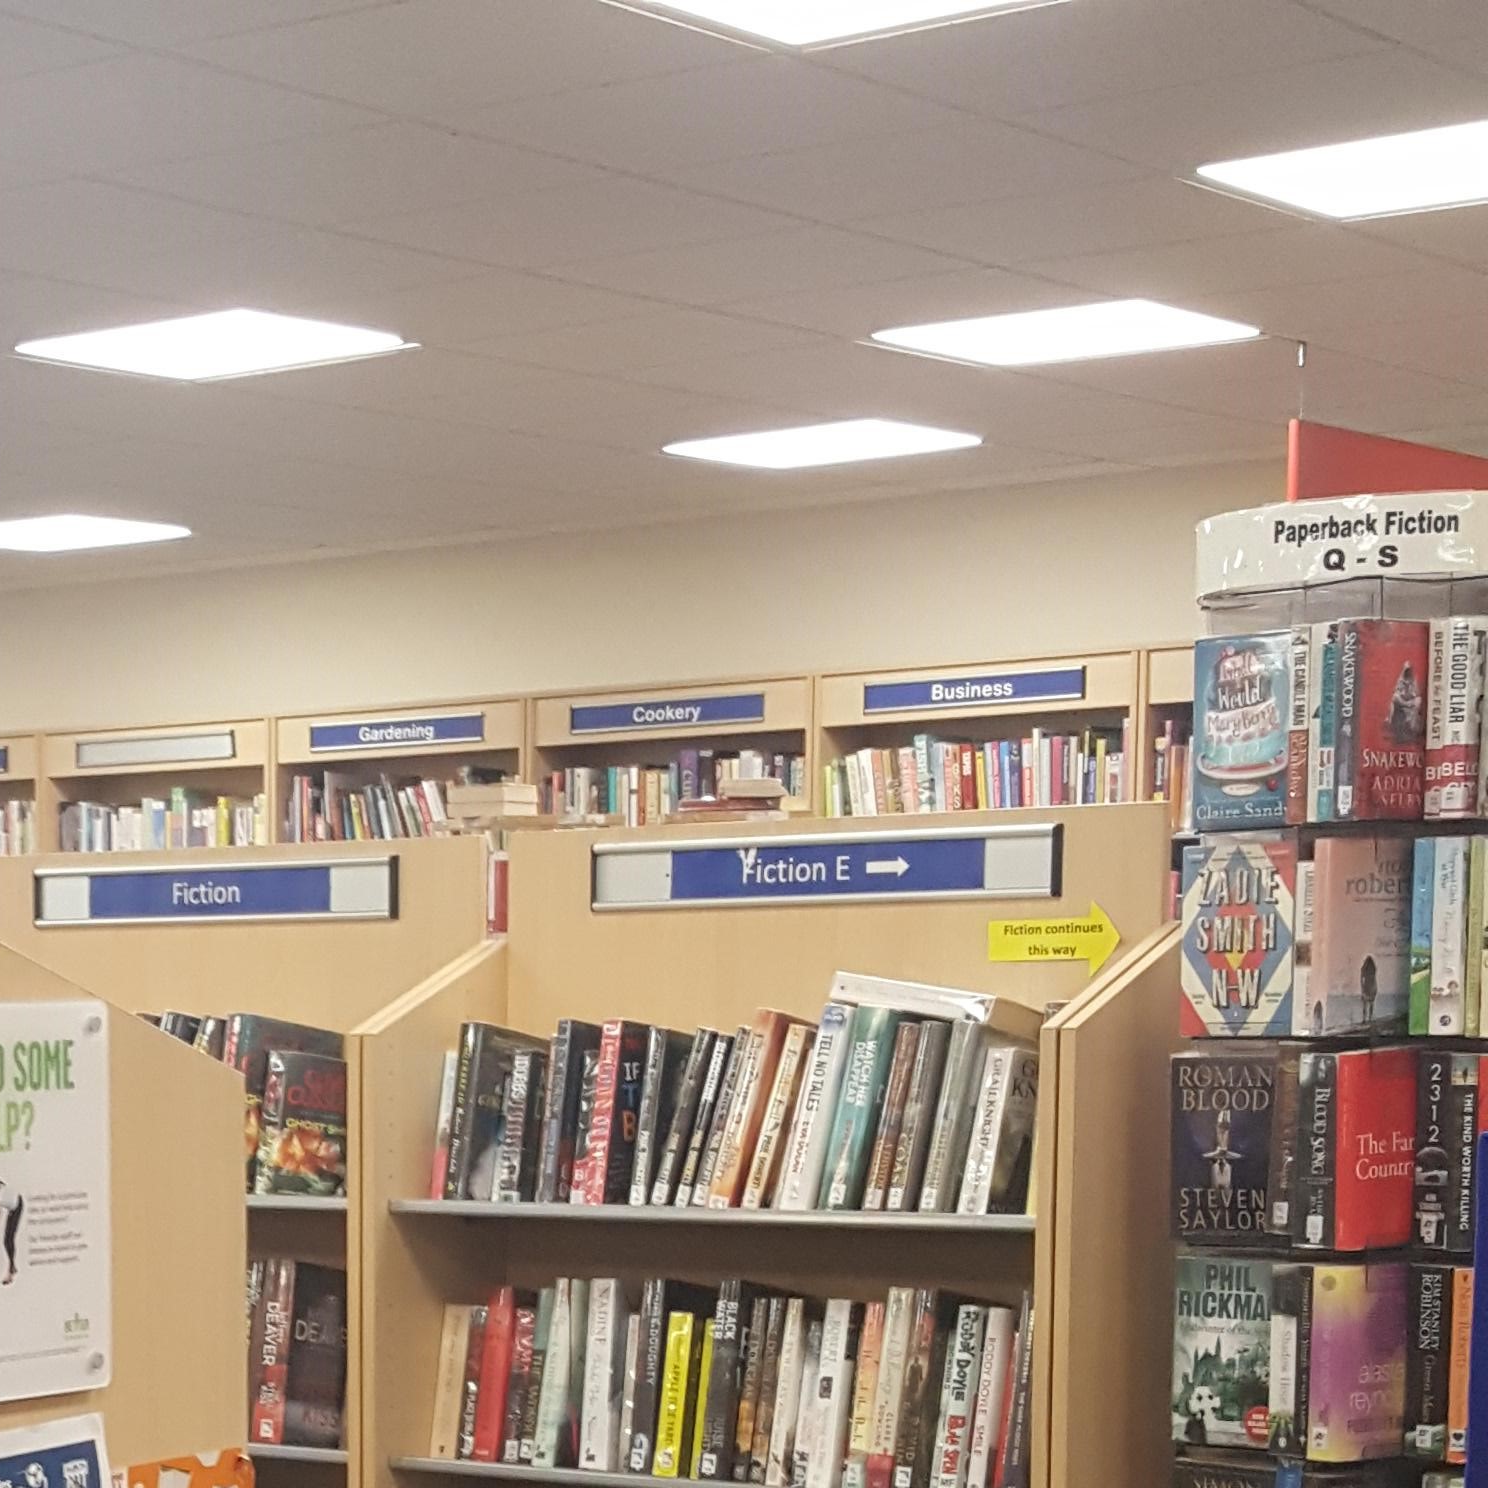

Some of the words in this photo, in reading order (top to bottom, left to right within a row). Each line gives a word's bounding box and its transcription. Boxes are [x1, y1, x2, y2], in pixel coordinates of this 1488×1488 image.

[1274, 514, 1378, 545] Paperback
[1385, 510, 1461, 537] Fiction
[1323, 547, 1346, 572] Q
[1378, 545, 1399, 568] S
[1452, 621, 1469, 651] THE
[1432, 631, 1444, 684] BEFORE
[1450, 652, 1468, 691] GOOD
[1341, 631, 1357, 718] SNAKEWOOD
[930, 680, 1013, 702] Business
[633, 703, 701, 725] Cookery
[1431, 699, 1443, 741] FEAST
[1448, 694, 1466, 724] LIAR
[359, 722, 434, 744] Gardening
[834, 855, 850, 882] E
[172, 881, 241, 907] Fiction
[1197, 864, 1280, 906] ZADIE
[1003, 924, 1043, 938] Fiction
[1045, 920, 1104, 937] continues
[1195, 913, 1277, 953] SMITH
[1028, 944, 1050, 957] this
[1052, 945, 1078, 959] way
[819, 1034, 834, 1059] TELL
[12, 1039, 75, 1091] SOME
[815, 1060, 829, 1077] NO
[1178, 1064, 1274, 1089] ROMAN
[805, 1080, 826, 1113] TALES
[1181, 1087, 1270, 1111] BLOOD
[1463, 1093, 1474, 1113] THE
[1357, 1132, 1388, 1155] The
[1392, 1131, 1416, 1154] Far
[1462, 1115, 1473, 1144] KIND
[1460, 1145, 1472, 1187] WORTH
[1180, 1187, 1266, 1209] STEVEN
[1458, 1188, 1471, 1231] KILLING
[1180, 1206, 1266, 1231] SAYLOR
[1205, 1263, 1257, 1293] PHIL
[714, 1300, 728, 1340] WATER
[724, 1301, 739, 1340] BLACK
[1417, 1273, 1434, 1351] ROBINSON
[260, 1301, 281, 1368] DEAVER
[983, 1337, 998, 1376] RODDY
[977, 1378, 992, 1416] DOYLE
[973, 1424, 986, 1457] SMILE
